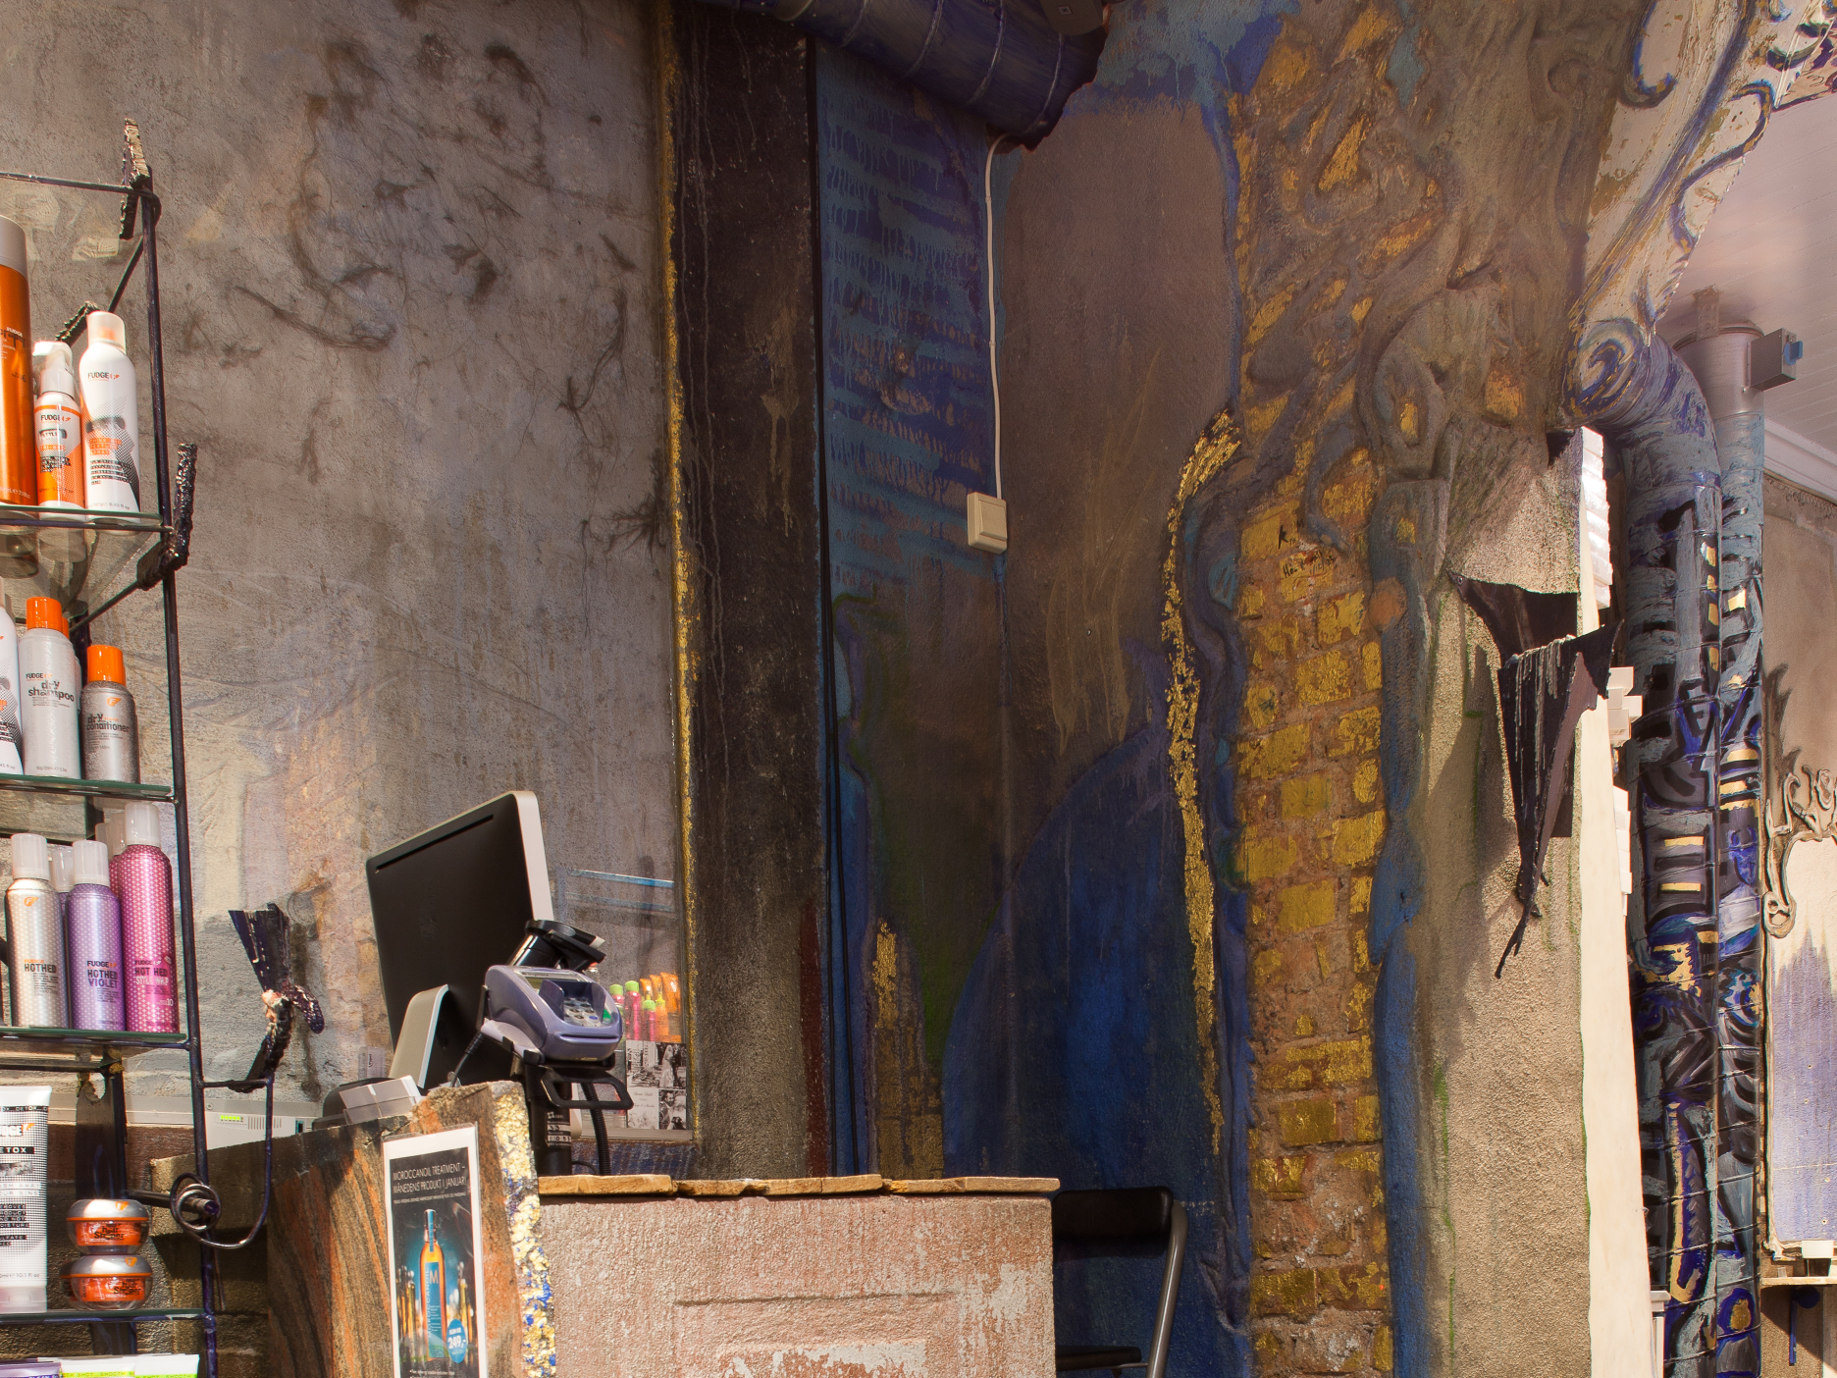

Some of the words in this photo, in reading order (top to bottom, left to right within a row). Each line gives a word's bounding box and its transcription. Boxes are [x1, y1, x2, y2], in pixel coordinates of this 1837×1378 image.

[88, 371, 110, 379] FUDGE
[41, 680, 60, 691] dry
[28, 687, 75, 702] shampoo
[88, 712, 103, 723] dry
[87, 720, 129, 733] conditioner
[24, 963, 57, 973] HOTHED
[87, 960, 110, 968] FUDGE
[87, 969, 118, 980] HOTHED
[88, 978, 118, 988] VIOLET
[393, 1167, 432, 1180] MOROCCANOIL
[432, 1162, 461, 1175] TREATMENT
[421, 1178, 442, 1191] PRODUKT
[429, 1269, 439, 1284] M
